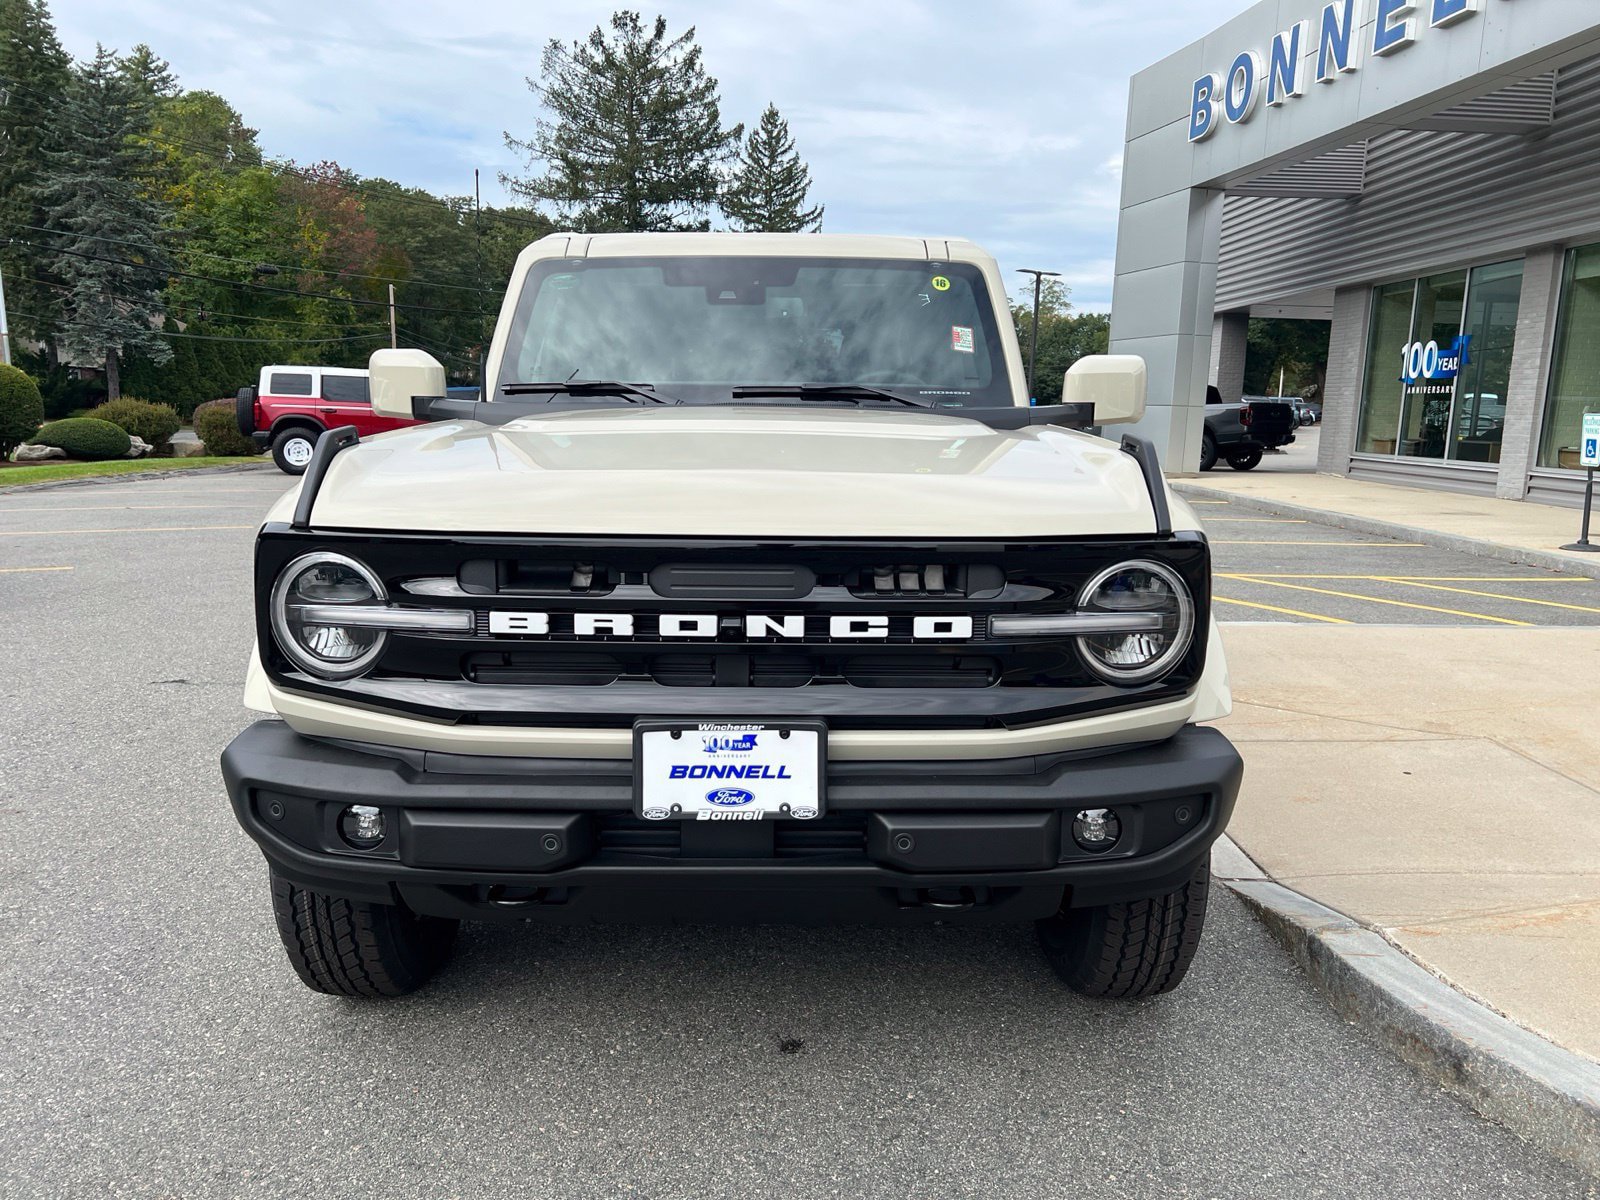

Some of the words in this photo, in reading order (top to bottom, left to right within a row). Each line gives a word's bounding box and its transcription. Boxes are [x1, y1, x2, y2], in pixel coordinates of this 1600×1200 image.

[1188, 0, 1477, 143] BONNE
[1401, 340, 1438, 379] 100
[488, 610, 973, 639] BRONCO
[698, 723, 765, 731] Winchester
[702, 735, 733, 751] 100
[733, 742, 751, 750] YEAR
[669, 765, 792, 779] BONNELL
[714, 791, 746, 804] Ford
[696, 809, 764, 820] Bonnell
